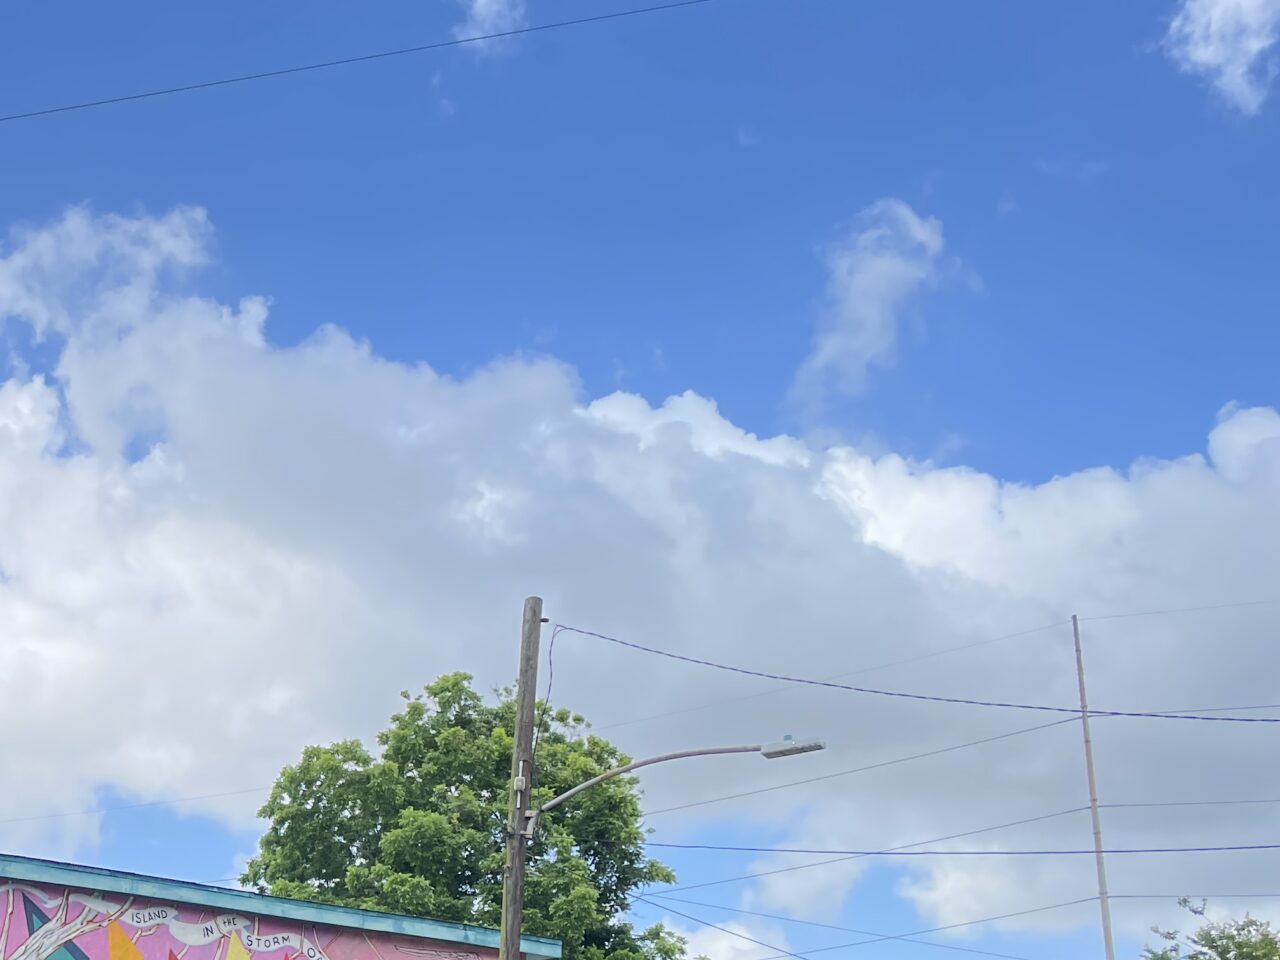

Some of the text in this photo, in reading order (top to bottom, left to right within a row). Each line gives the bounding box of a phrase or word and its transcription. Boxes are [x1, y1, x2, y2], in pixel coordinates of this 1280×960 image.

[131, 910, 168, 924] ISLAND
[203, 925, 214, 938] IN
[246, 934, 291, 948] STORM
